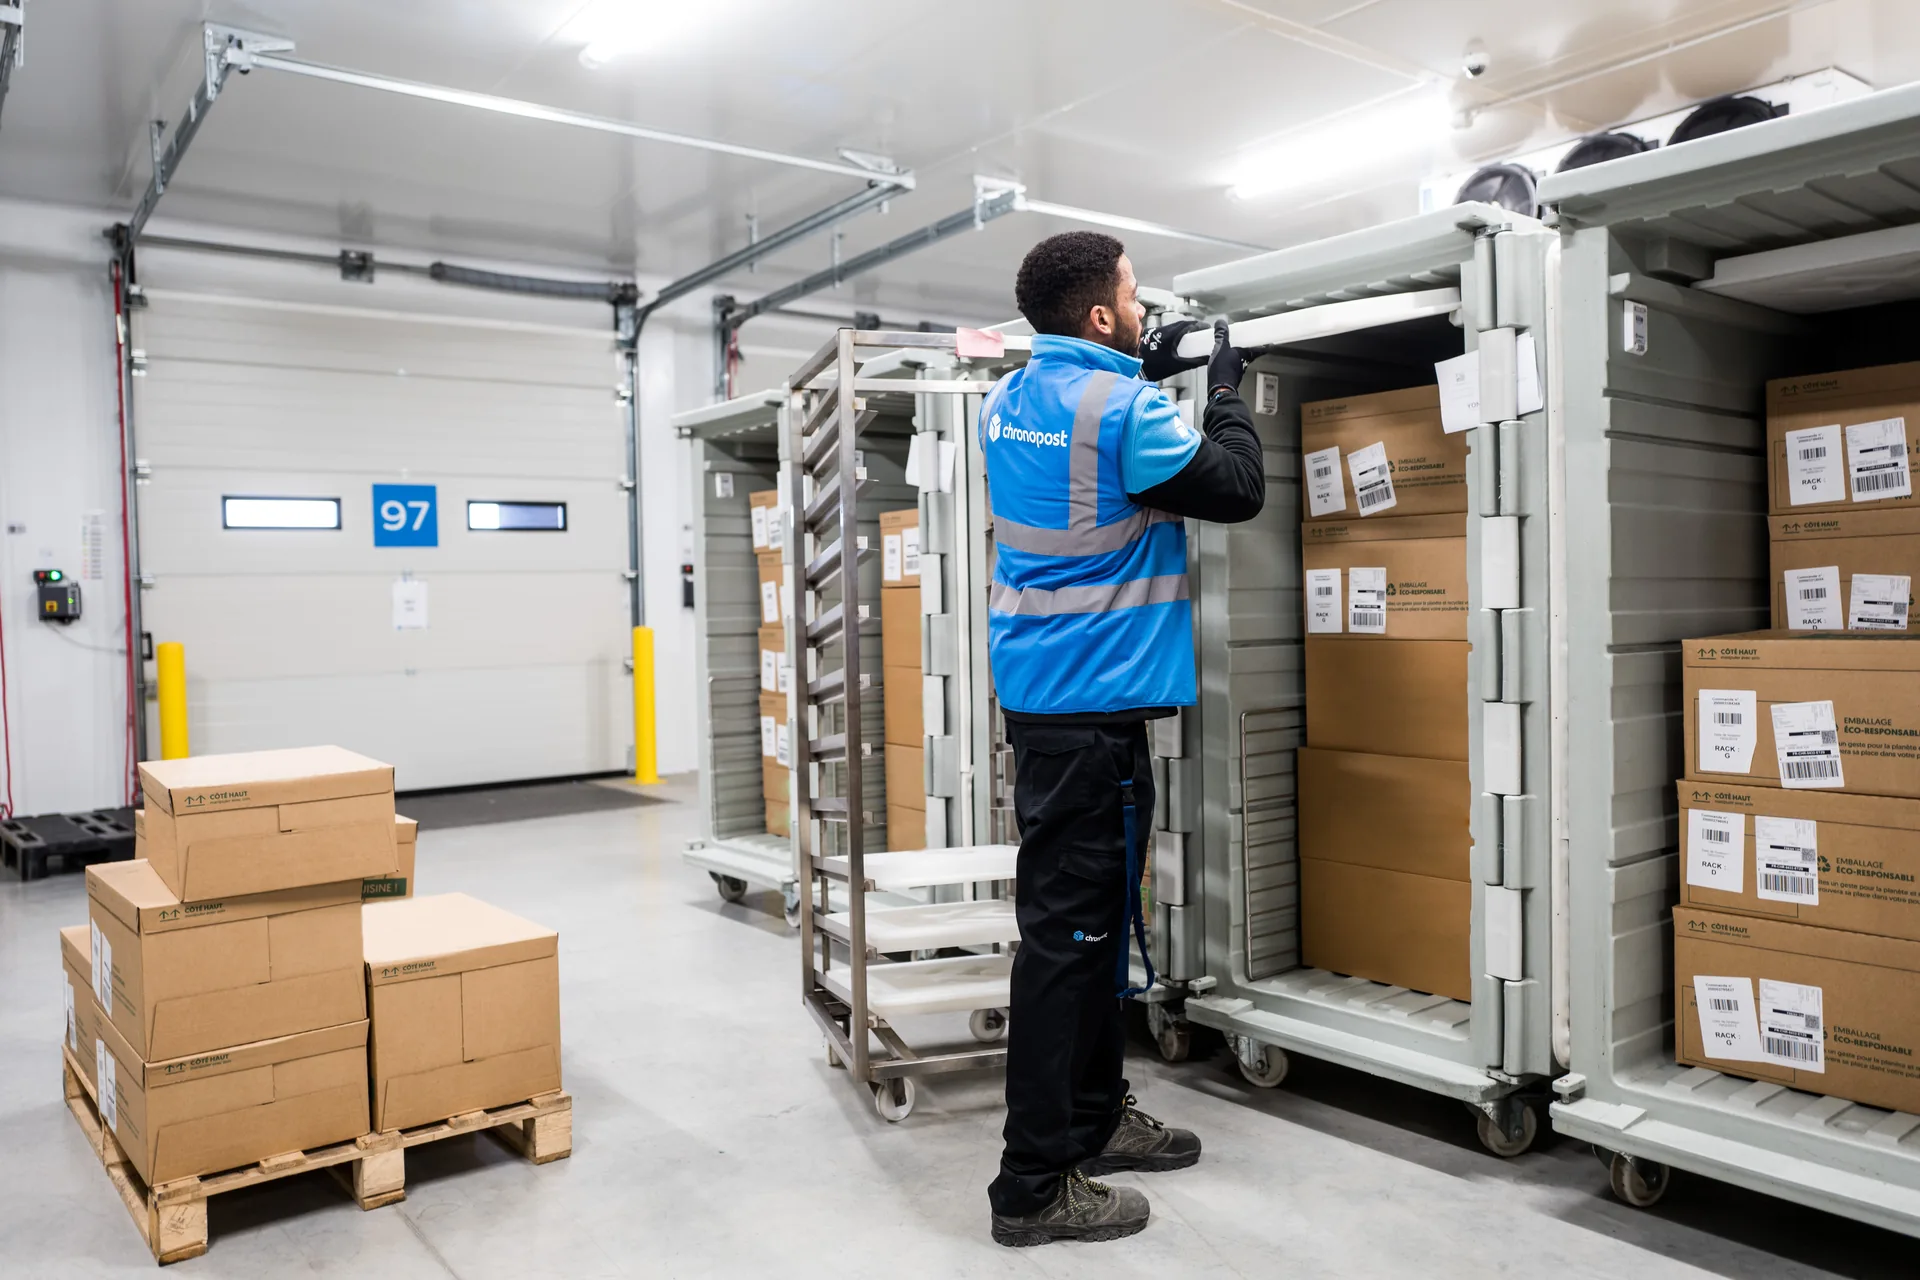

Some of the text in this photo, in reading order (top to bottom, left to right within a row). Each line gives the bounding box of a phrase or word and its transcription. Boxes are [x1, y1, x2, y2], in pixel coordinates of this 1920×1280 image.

[1003, 422, 1068, 448] chronopost
[1802, 477, 1822, 485] RACK
[380, 500, 430, 531] 97
[1844, 717, 1892, 726] EMBALLAGE
[1844, 726, 1920, 737] ÉCO-RESPONSABL
[209, 792, 227, 800] CÔTÉ
[1714, 792, 1731, 800] CÔTÉ
[1702, 861, 1722, 869] RACK
[1836, 857, 1884, 869] EMBALLAGE
[1836, 866, 1915, 882] ÉCO-RESPONSABLE
[1840, 882, 1858, 890] geste
[1883, 886, 1908, 896] planète
[1853, 890, 1870, 898] place
[1872, 892, 1888, 900] dans
[1889, 895, 1907, 903] votre
[185, 905, 203, 914] CÔTÉ
[1711, 923, 1748, 934] CÔTÉ HAUT
[418, 961, 435, 969] HAUT
[1833, 1025, 1881, 1041] EMBALLAGE
[1833, 1034, 1913, 1056] ÉCO-RESPONSABLE
[190, 1053, 229, 1066] CÔTÉ HAUT
[1837, 1051, 1855, 1059] geste
[1857, 1054, 1872, 1062] pour
[1881, 1059, 1906, 1068] planète
[1850, 1061, 1868, 1069] place
[1869, 1064, 1885, 1072] dans
[1887, 1068, 1904, 1076] votre
